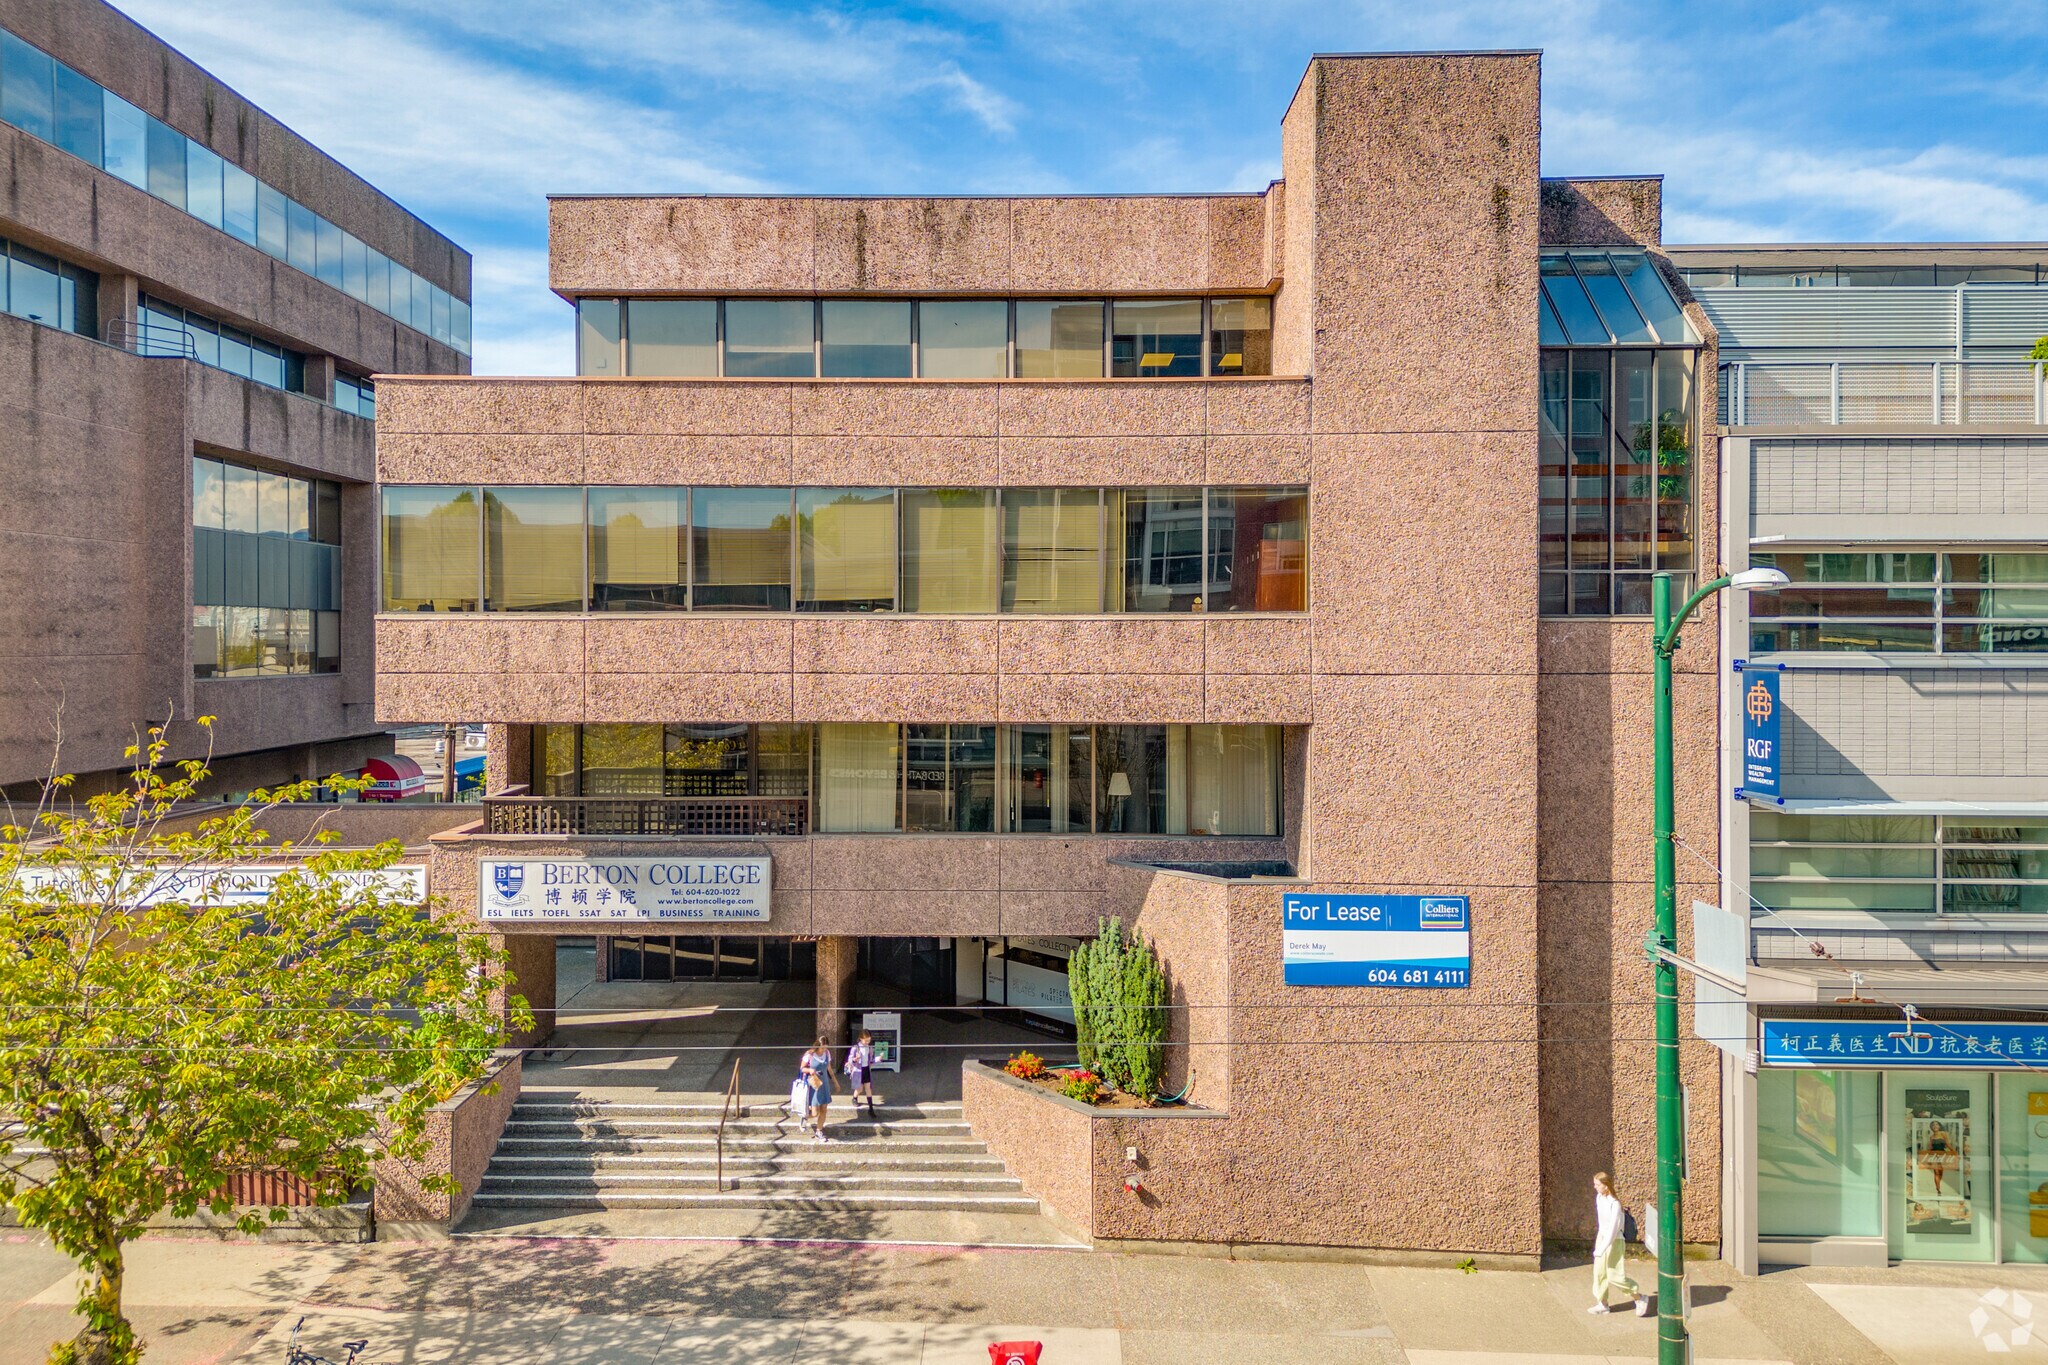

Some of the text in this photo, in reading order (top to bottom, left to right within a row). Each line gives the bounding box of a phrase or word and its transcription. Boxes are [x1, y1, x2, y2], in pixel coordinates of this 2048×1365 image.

[1748, 739, 1772, 759] RGF
[1748, 764, 1772, 773] INTEGRATED
[541, 863, 761, 886] BERTON COLLEGE
[545, 887, 637, 905] 博顿学院
[671, 888, 741, 896] Tel: 604-620-1022
[657, 897, 754, 905] www.bertoncollege.com
[1425, 903, 1460, 914] Colliers
[487, 909, 760, 917] ESL IELTS TOEFL SSAT SAT LPI BUSINESS TRAINING
[1288, 900, 1381, 921] For Lease
[1289, 942, 1327, 951] Derek May
[1368, 969, 1465, 984] 604 681 4111
[1780, 1032, 1889, 1054] 柯正義医生
[1893, 1036, 1934, 1054] ND
[1939, 1034, 2048, 1056] 抗衰老医学
